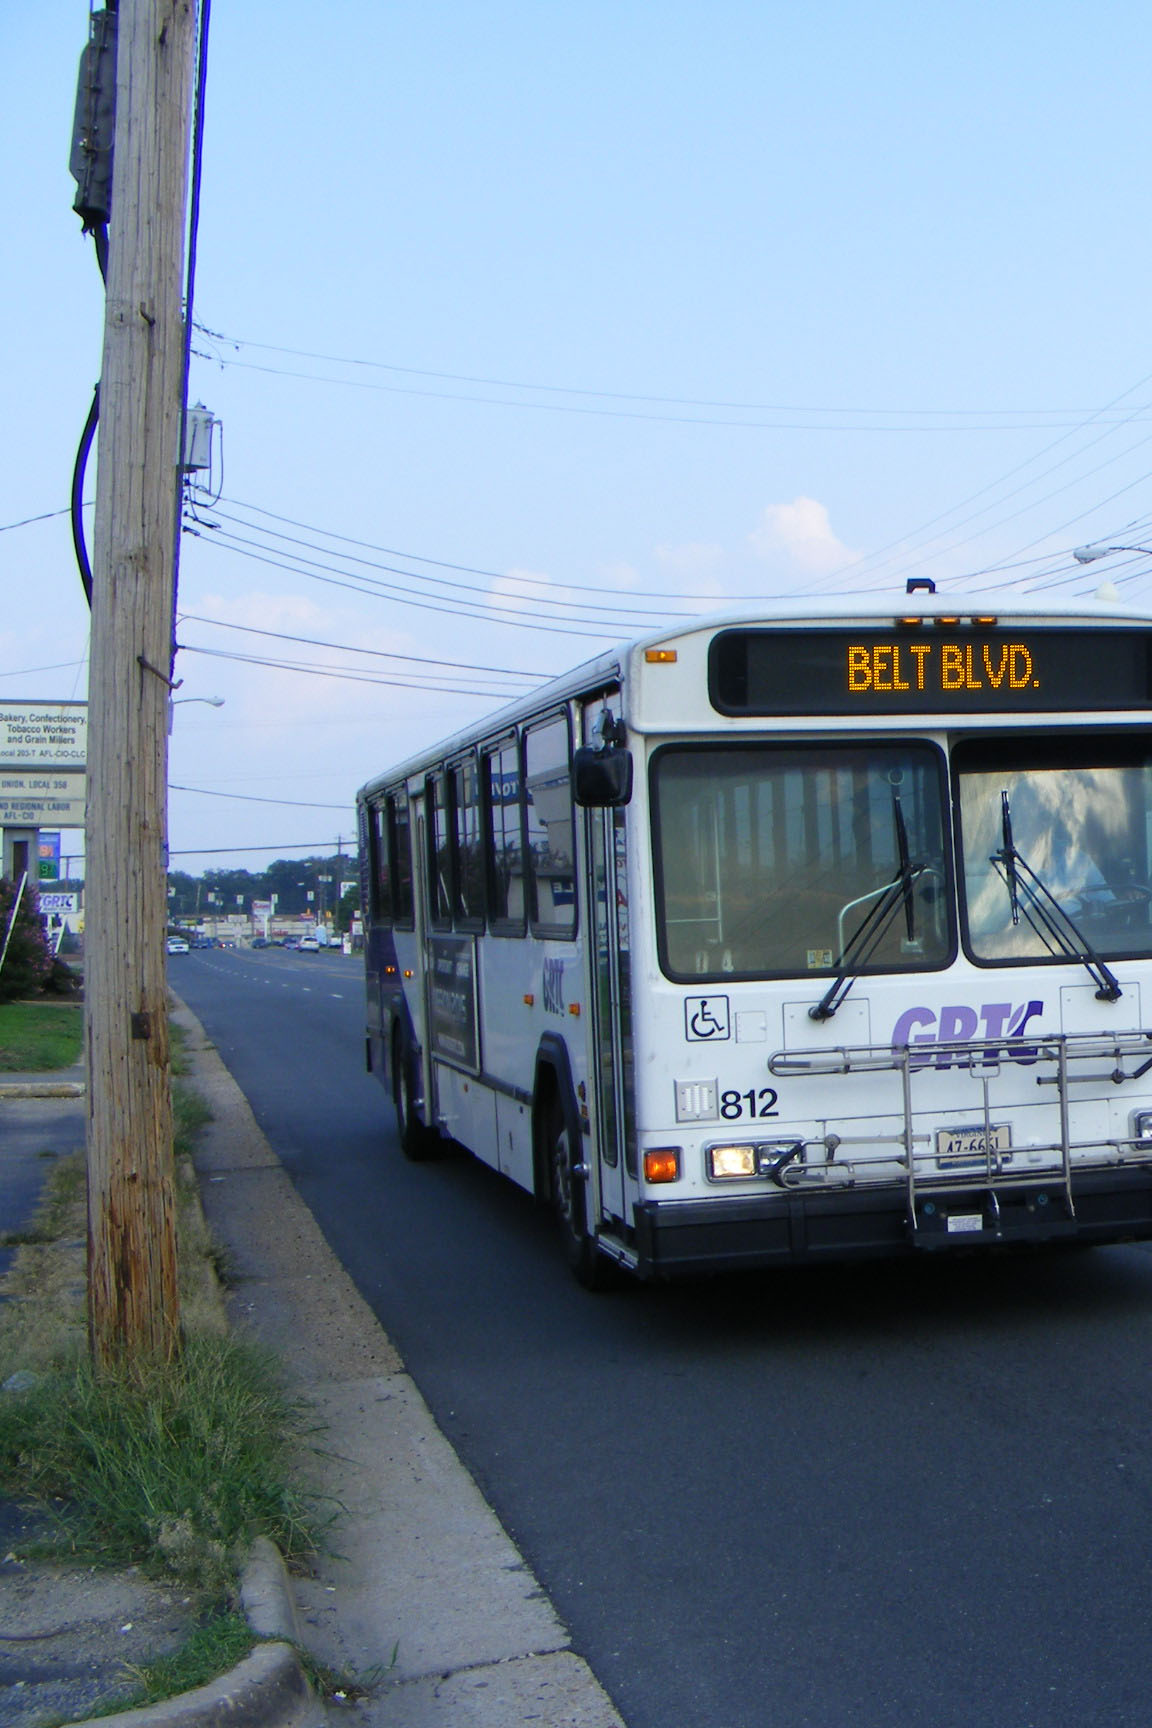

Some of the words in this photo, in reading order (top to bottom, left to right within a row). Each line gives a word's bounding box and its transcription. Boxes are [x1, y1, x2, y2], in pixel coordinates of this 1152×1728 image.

[849, 646, 931, 690] BELT
[942, 645, 1040, 689] BLVD.
[8, 724, 41, 733] Tobacco
[43, 725, 76, 734] Workers
[7, 735, 23, 743] and
[25, 735, 47, 744] Grain
[49, 736, 75, 744] Millers
[0, 749, 15, 757] ocal
[29, 780, 50, 789] LOCAL
[47, 803, 71, 811] LABOR
[42, 894, 74, 908] GRTC
[891, 1000, 1044, 1073] GRTC
[720, 1088, 779, 1120] 812
